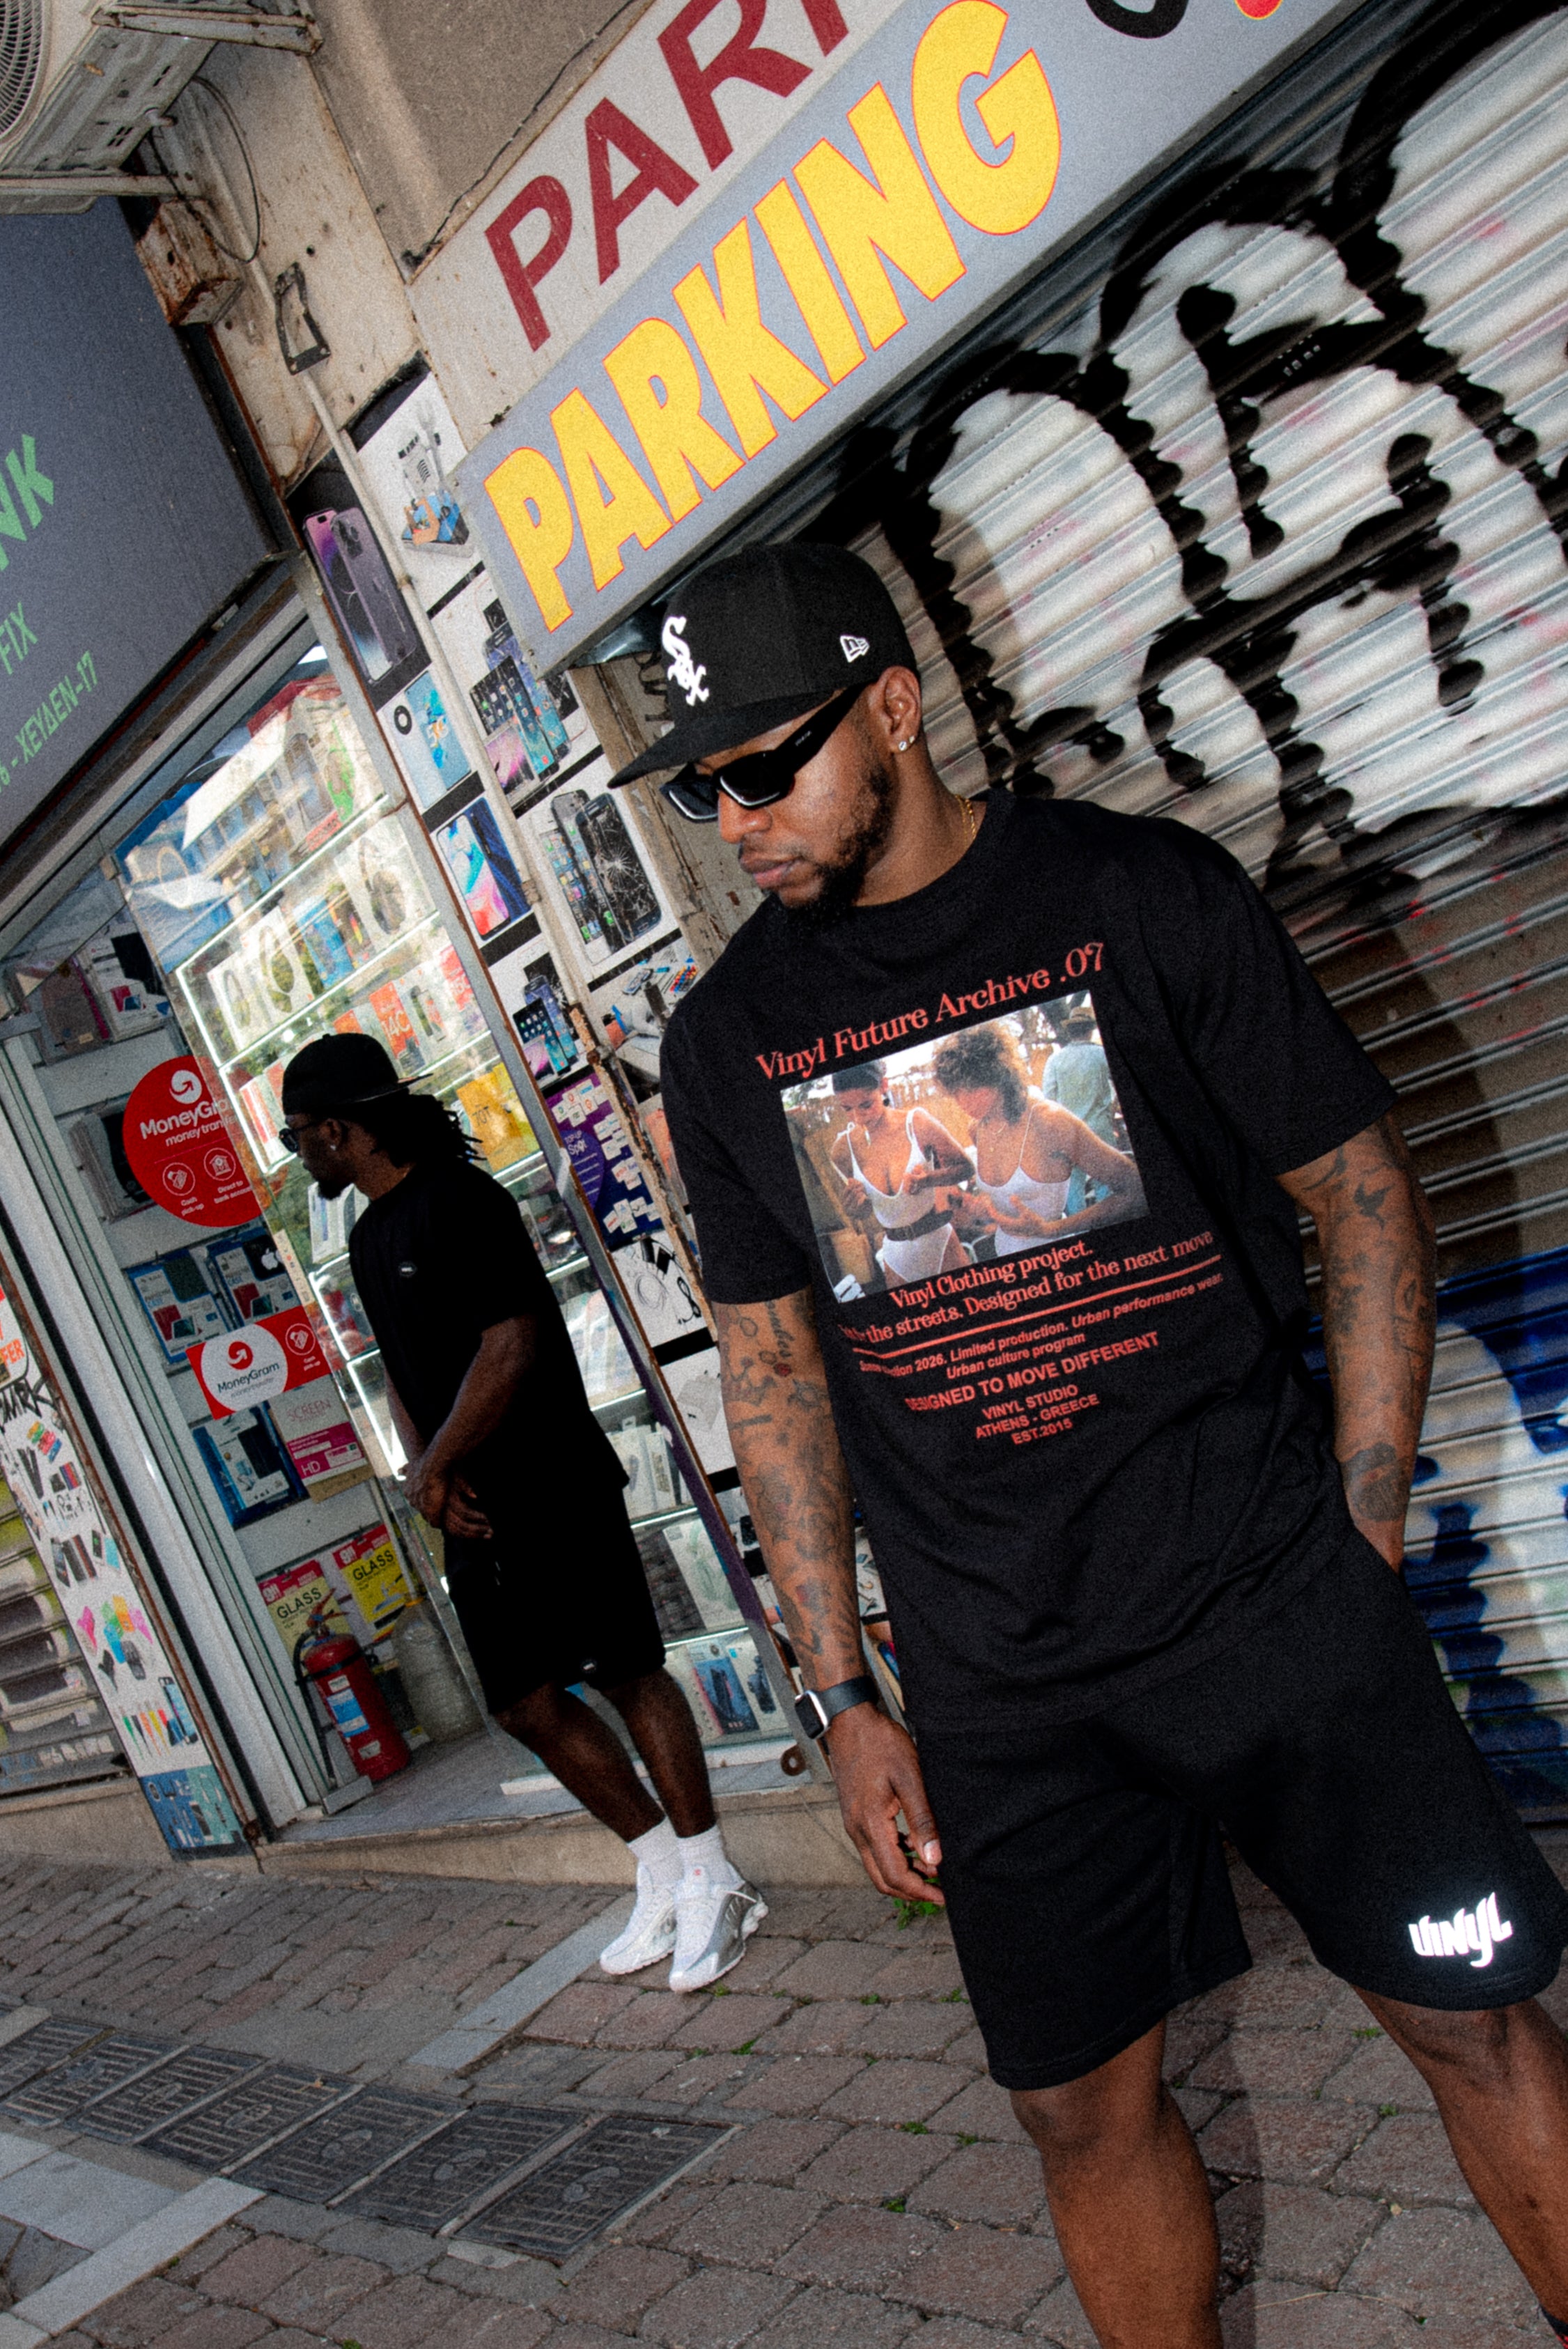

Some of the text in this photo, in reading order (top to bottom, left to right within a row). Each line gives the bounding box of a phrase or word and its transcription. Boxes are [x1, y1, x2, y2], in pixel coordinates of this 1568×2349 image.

[483, 0, 850, 352] PAR
[483, 0, 1062, 630] PARKING
[756, 943, 1104, 1078] Vinyl Future Archive .07
[165, 1126, 202, 1147] money
[866, 1326, 894, 1342] the
[896, 1308, 963, 1335] streets.
[964, 1276, 1051, 1315] Designed
[1055, 1272, 1083, 1291] for
[1087, 1262, 1121, 1281] the
[1124, 1247, 1167, 1271] next
[1173, 1228, 1214, 1257] move
[890, 1282, 937, 1308] Vinyl
[938, 1263, 1016, 1295] Clothing
[1019, 1241, 1092, 1279] project.
[915, 1354, 947, 1372] 2026.
[951, 1340, 996, 1362] Limited
[998, 1323, 1066, 1351] production.
[1071, 1310, 1110, 1328] Urban
[1113, 1286, 1195, 1318] performance
[217, 1361, 280, 1395] MoneyGram
[906, 1332, 1158, 1411] DESIGNED TO MOVE DIFFERENT
[947, 1333, 1089, 1379] Urban culture program
[286, 1398, 332, 1423] SCREEN
[976, 1416, 1030, 1439] ATHENS
[1040, 1395, 1099, 1420] GREECE
[982, 1385, 1078, 1420] VINYL STUDIO
[1011, 1418, 1072, 1444] EST.2015
[300, 1459, 321, 1480] HD
[352, 1549, 395, 1582] GLASS
[276, 1587, 323, 1620] GLASS
